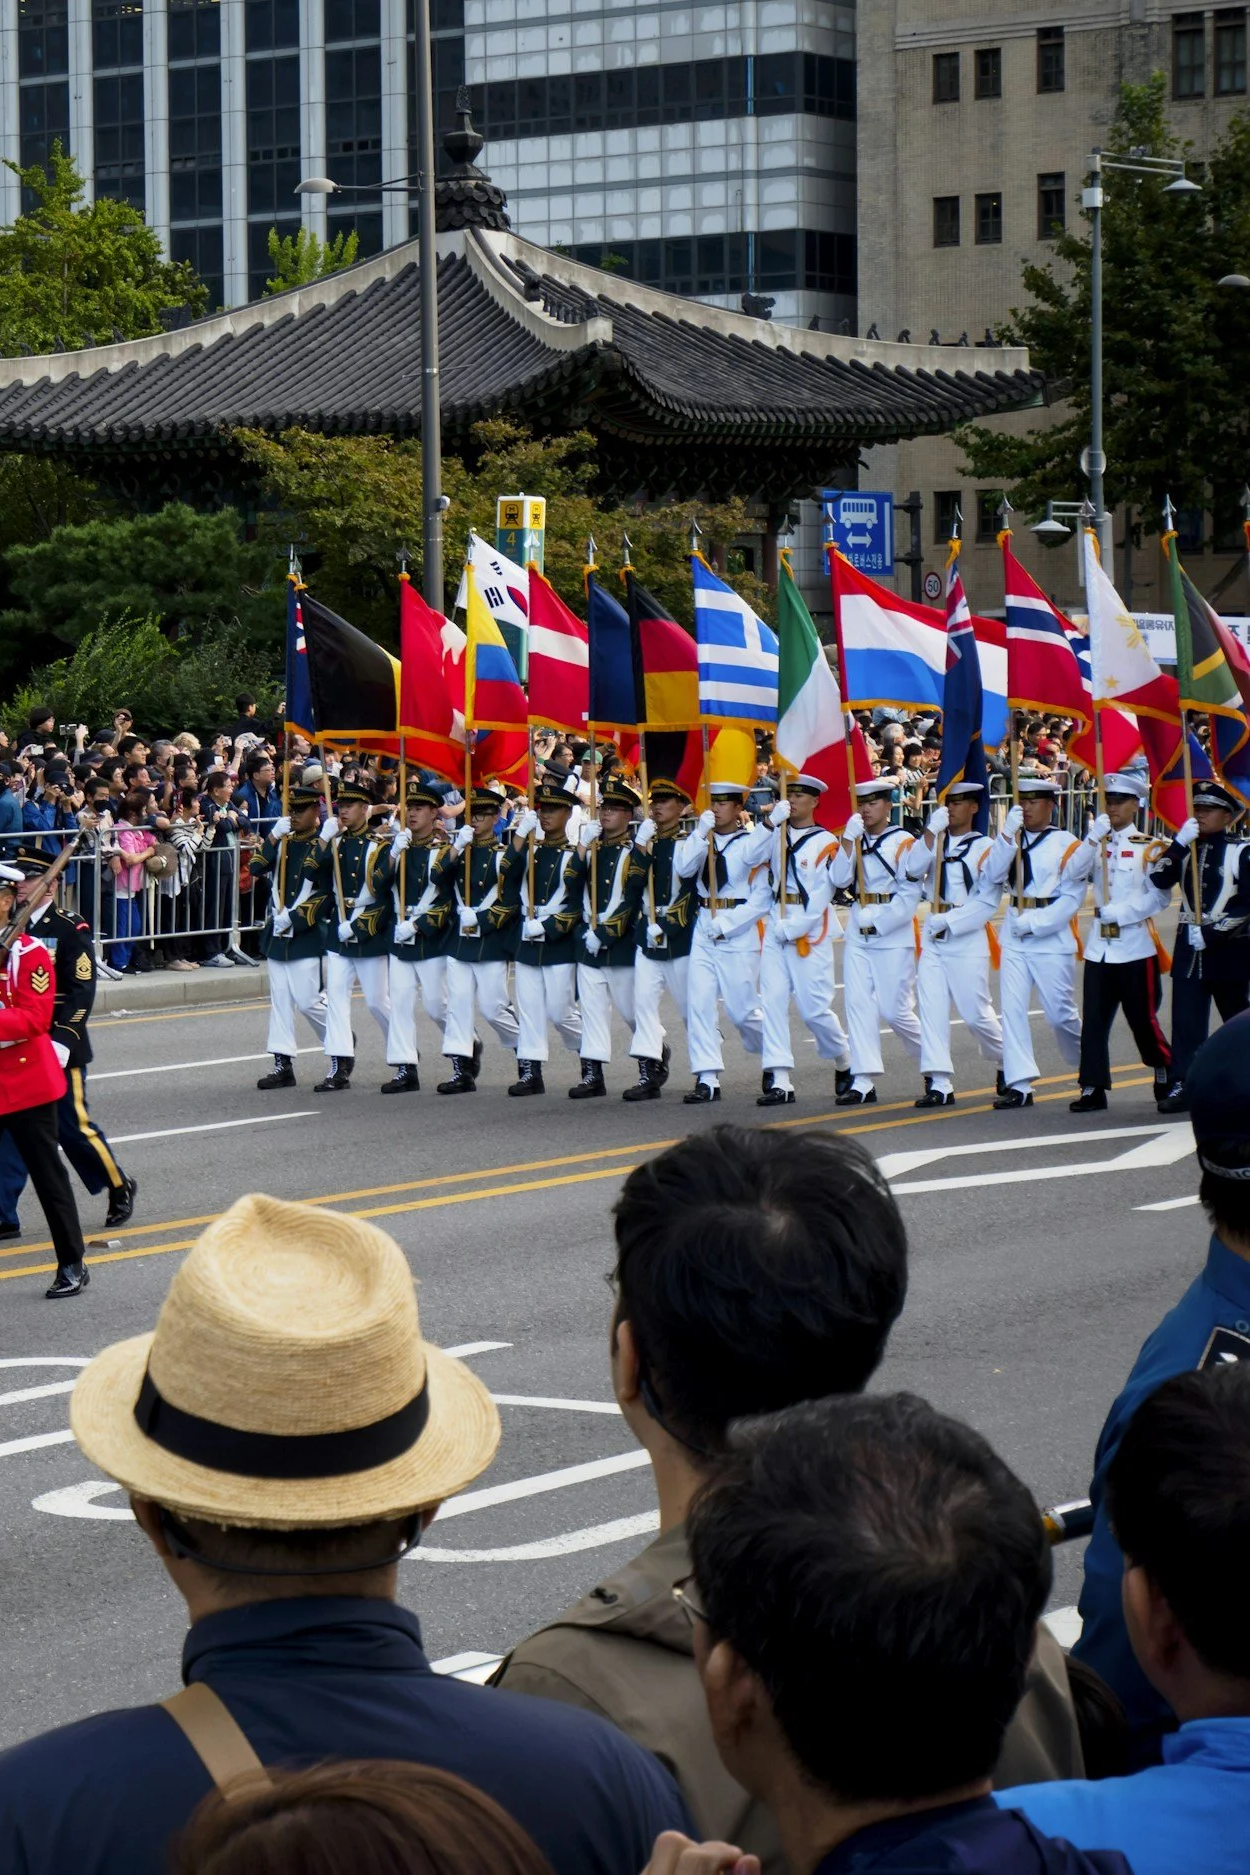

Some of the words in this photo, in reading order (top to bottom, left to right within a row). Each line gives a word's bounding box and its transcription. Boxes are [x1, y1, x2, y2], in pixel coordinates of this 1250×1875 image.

[506, 532, 516, 547] 4
[844, 552, 883, 570] 차로버스전용
[928, 580, 939, 593] 50
